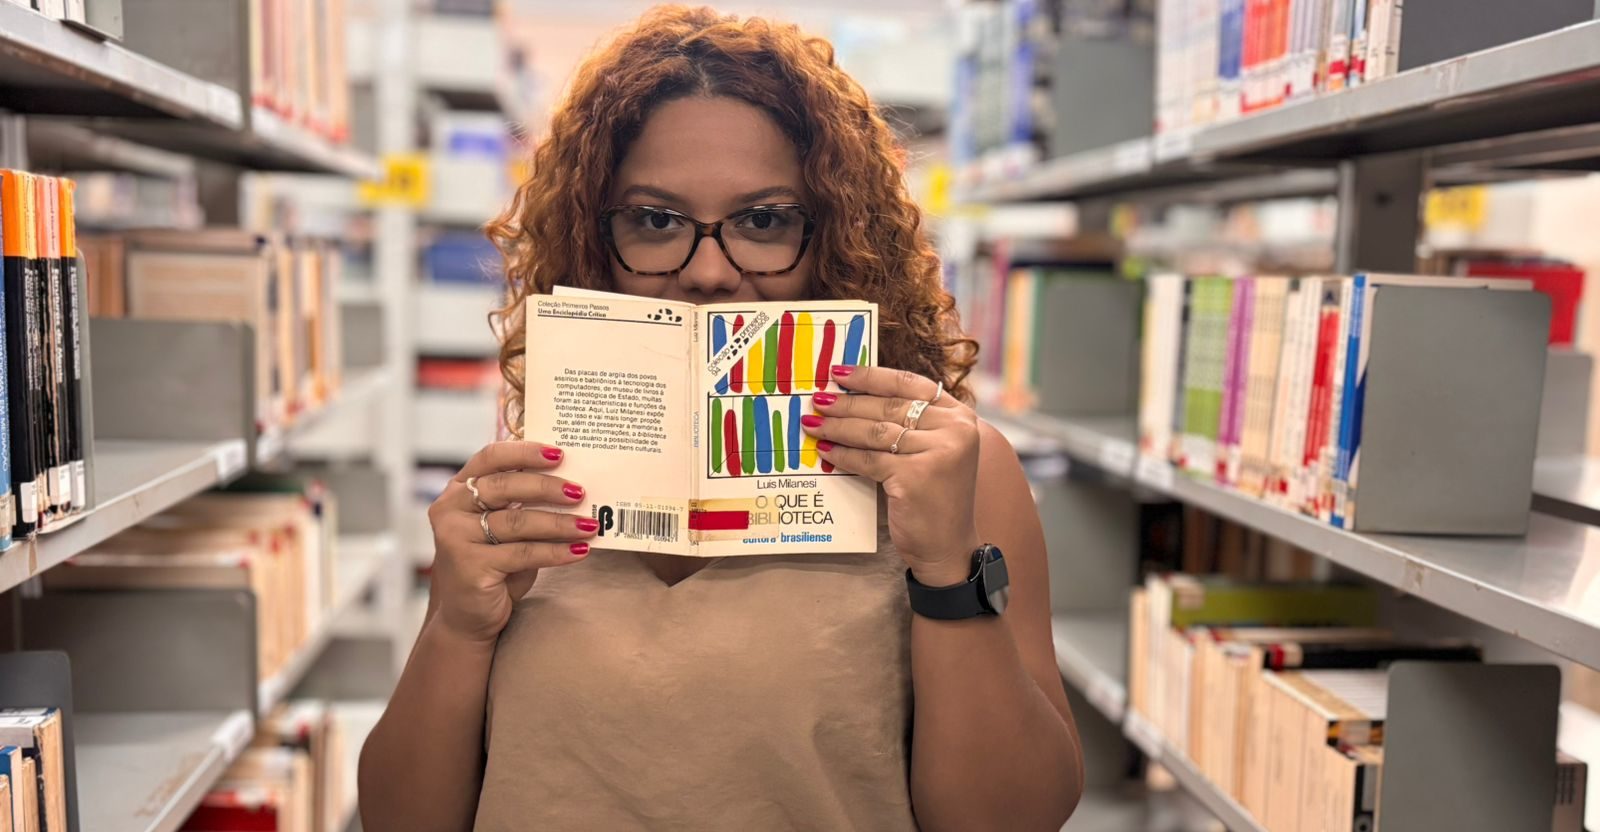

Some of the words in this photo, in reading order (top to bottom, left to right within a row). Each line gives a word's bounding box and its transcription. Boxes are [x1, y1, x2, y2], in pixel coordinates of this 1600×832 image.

[740, 311, 765, 338] primeiros
[748, 316, 770, 338] passos
[708, 348, 730, 372] coleção
[623, 380, 654, 388] tecnologia
[634, 402, 657, 410] funções
[757, 480, 776, 489] Luis
[779, 479, 816, 488] Milanesi
[756, 495, 768, 509] O
[775, 494, 808, 510] QUE
[814, 491, 824, 507] É
[781, 532, 832, 543] brasiliense
